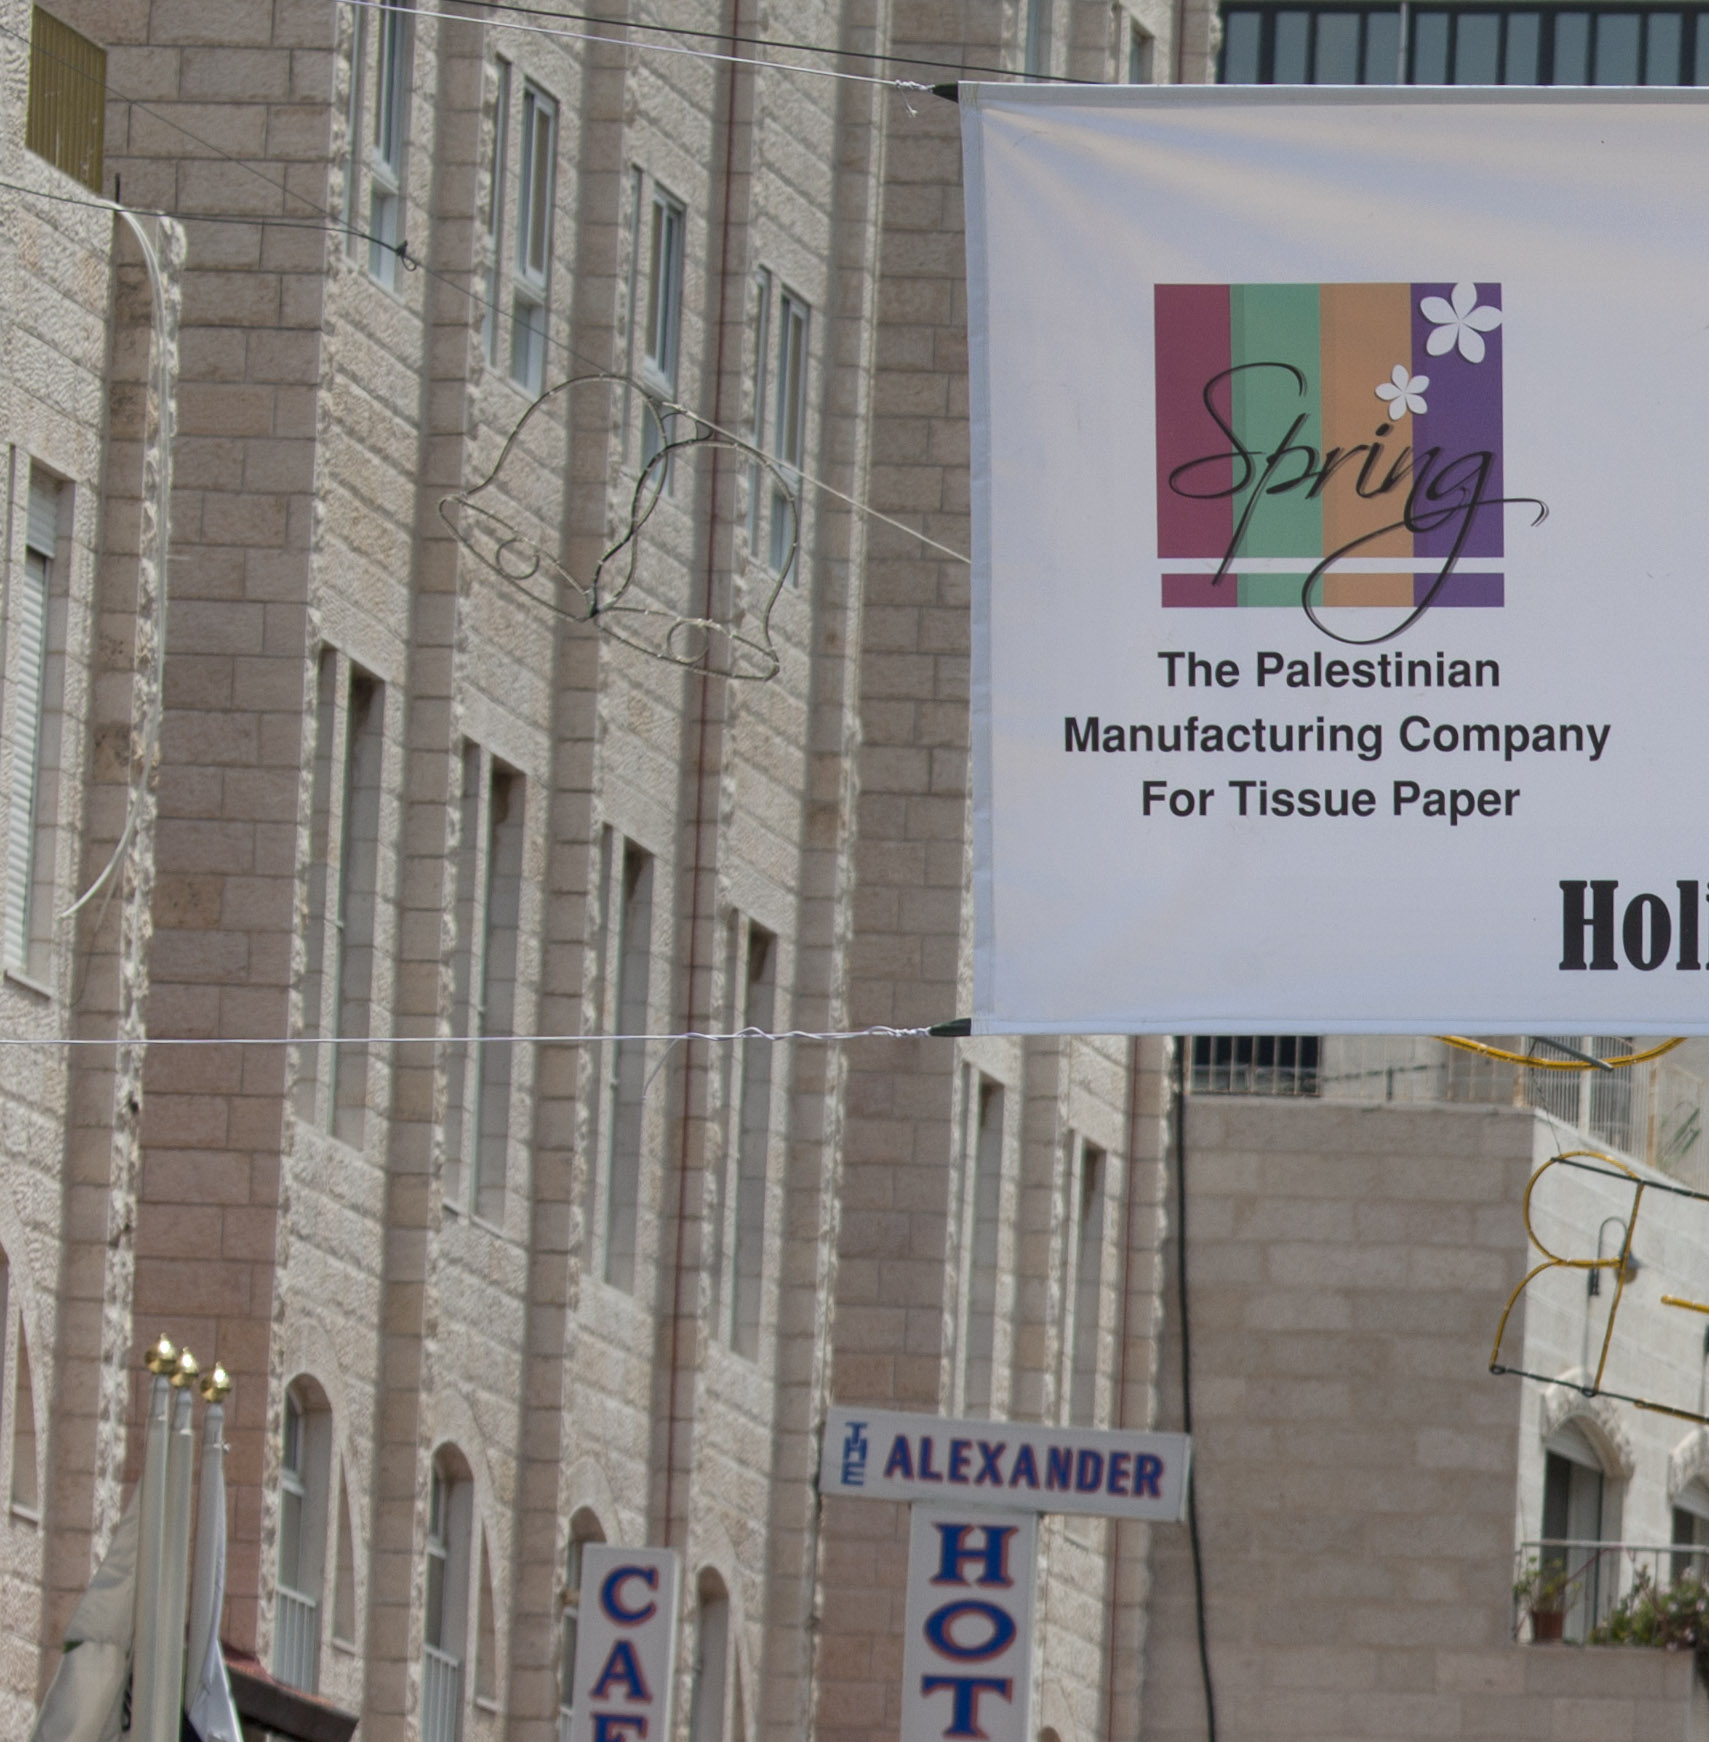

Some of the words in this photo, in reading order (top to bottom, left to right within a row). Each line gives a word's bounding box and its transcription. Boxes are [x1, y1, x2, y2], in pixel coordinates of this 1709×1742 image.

[1168, 361, 1549, 645] Spring
[1157, 651, 1241, 690] The
[1257, 650, 1501, 690] Palestinian
[1063, 715, 1384, 764] Manufacturing
[1399, 716, 1612, 764] Company
[1142, 780, 1216, 818] For
[1229, 780, 1377, 819] Tissue
[1394, 780, 1522, 828] Paper
[840, 1420, 869, 1487] THE
[883, 1433, 1165, 1499] ALEXANDER
